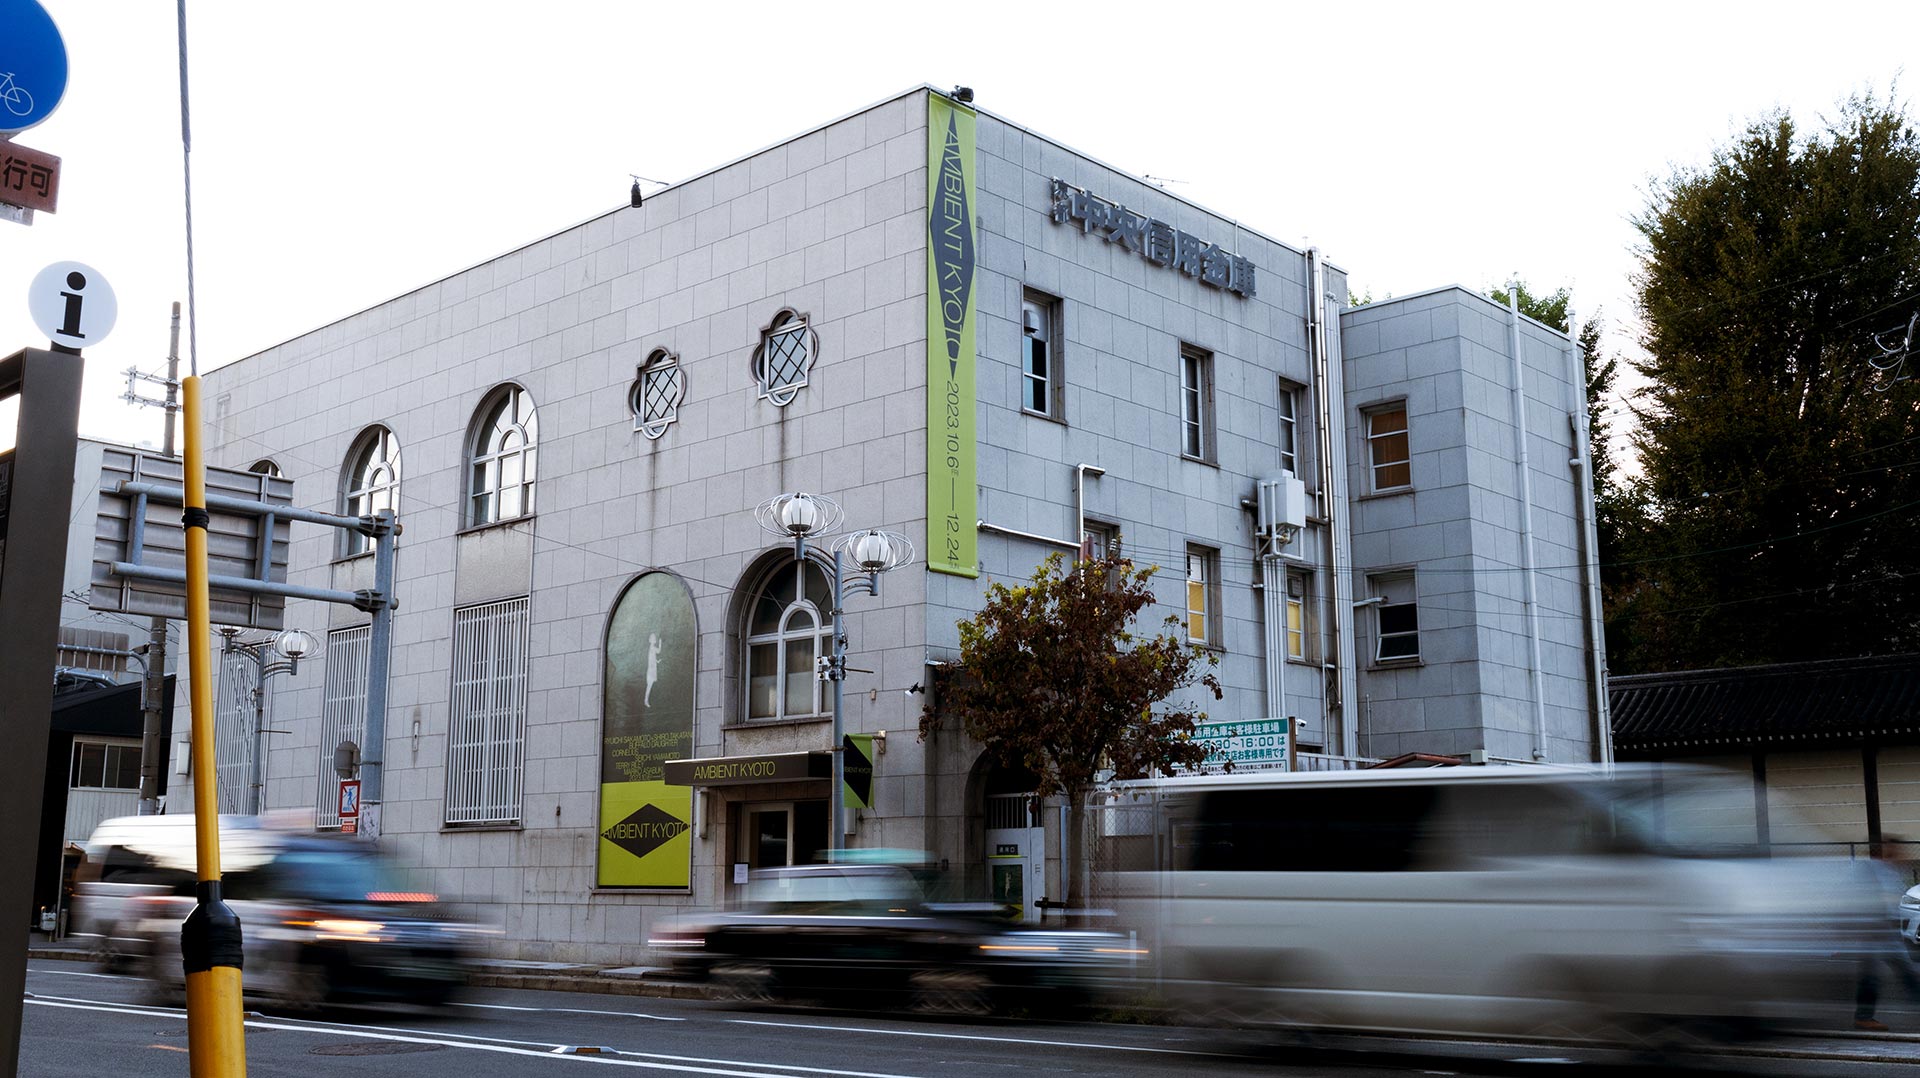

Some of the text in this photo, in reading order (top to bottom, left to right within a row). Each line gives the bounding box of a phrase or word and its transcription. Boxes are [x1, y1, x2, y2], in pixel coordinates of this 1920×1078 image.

[0, 155, 54, 198] 行可
[943, 128, 963, 362] AMBIENT KYOTO
[1071, 189, 1257, 298] 中央信用金庫
[946, 380, 960, 469] 2023.10.6
[693, 761, 776, 780] AMBIENT KYOTO
[602, 821, 689, 839] AMBIENT KYOTO
